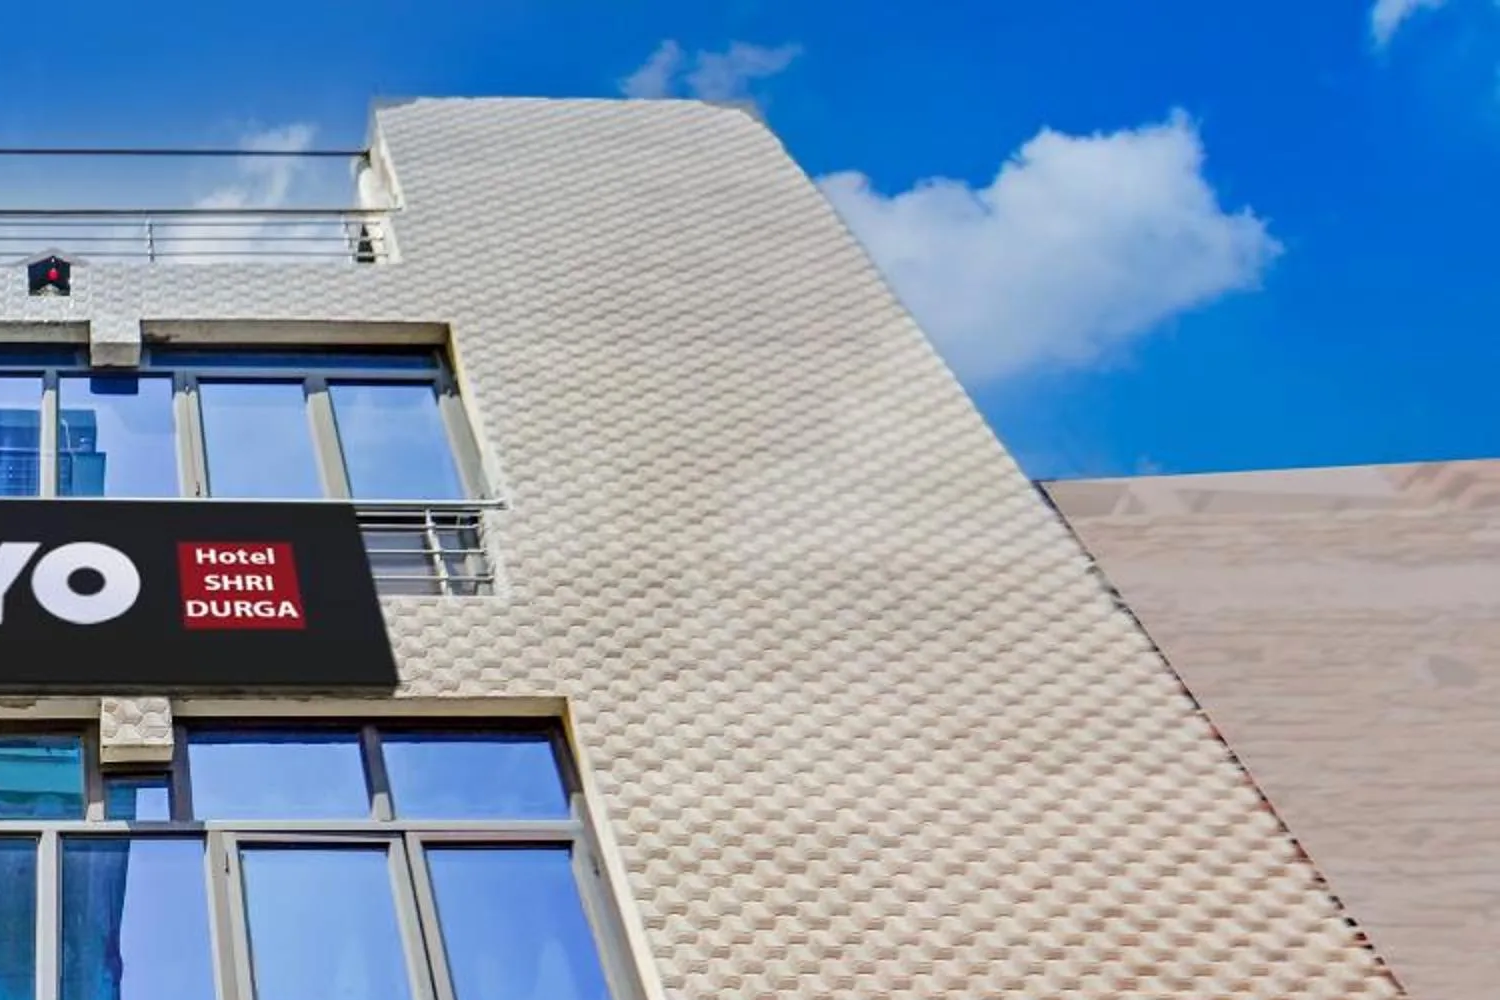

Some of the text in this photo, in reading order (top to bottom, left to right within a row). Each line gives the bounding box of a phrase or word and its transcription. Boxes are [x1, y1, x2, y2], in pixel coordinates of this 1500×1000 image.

[195, 547, 276, 565] Hotel
[203, 574, 275, 592] SHRI
[185, 600, 300, 619] DURGA
